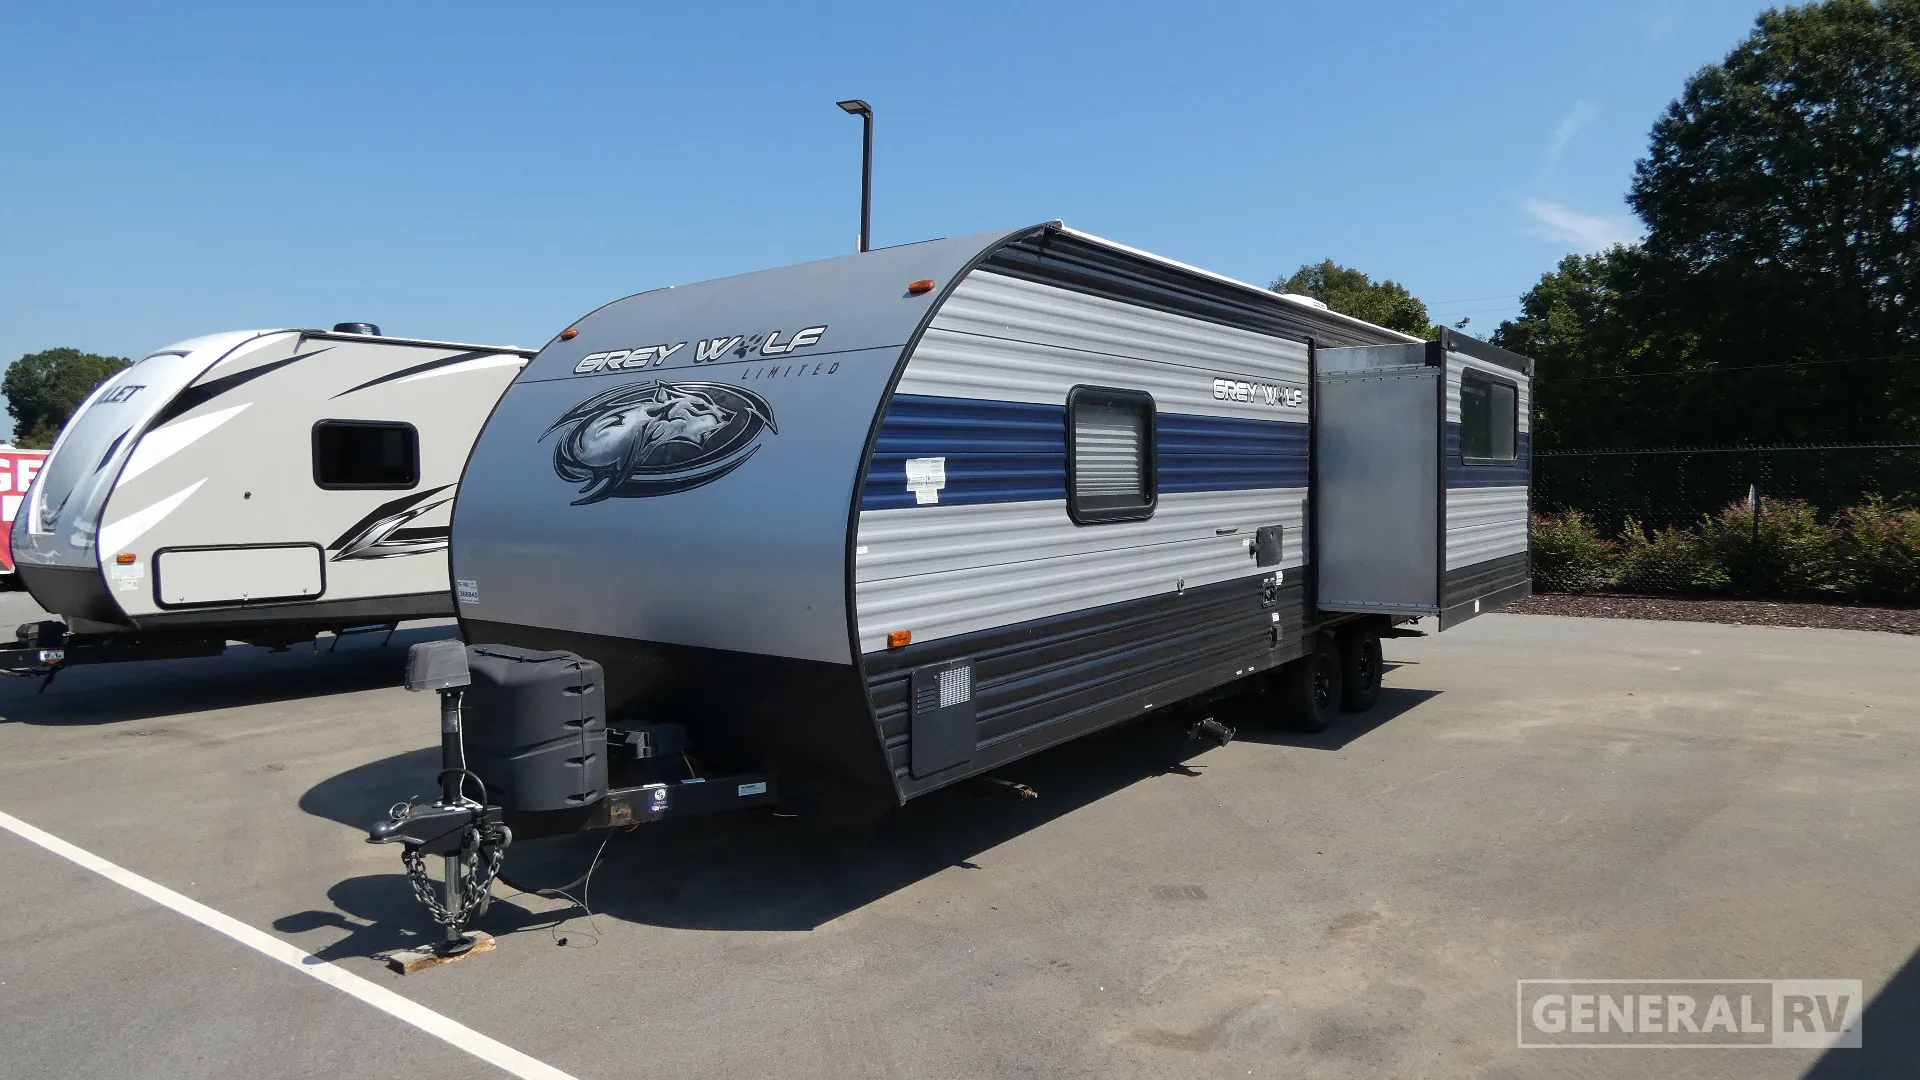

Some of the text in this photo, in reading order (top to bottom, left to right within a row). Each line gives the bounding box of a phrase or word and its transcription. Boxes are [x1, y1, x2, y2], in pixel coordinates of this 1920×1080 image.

[573, 340, 688, 375] GREY
[741, 361, 840, 380] LIMITED
[1212, 376, 1258, 403] GREY
